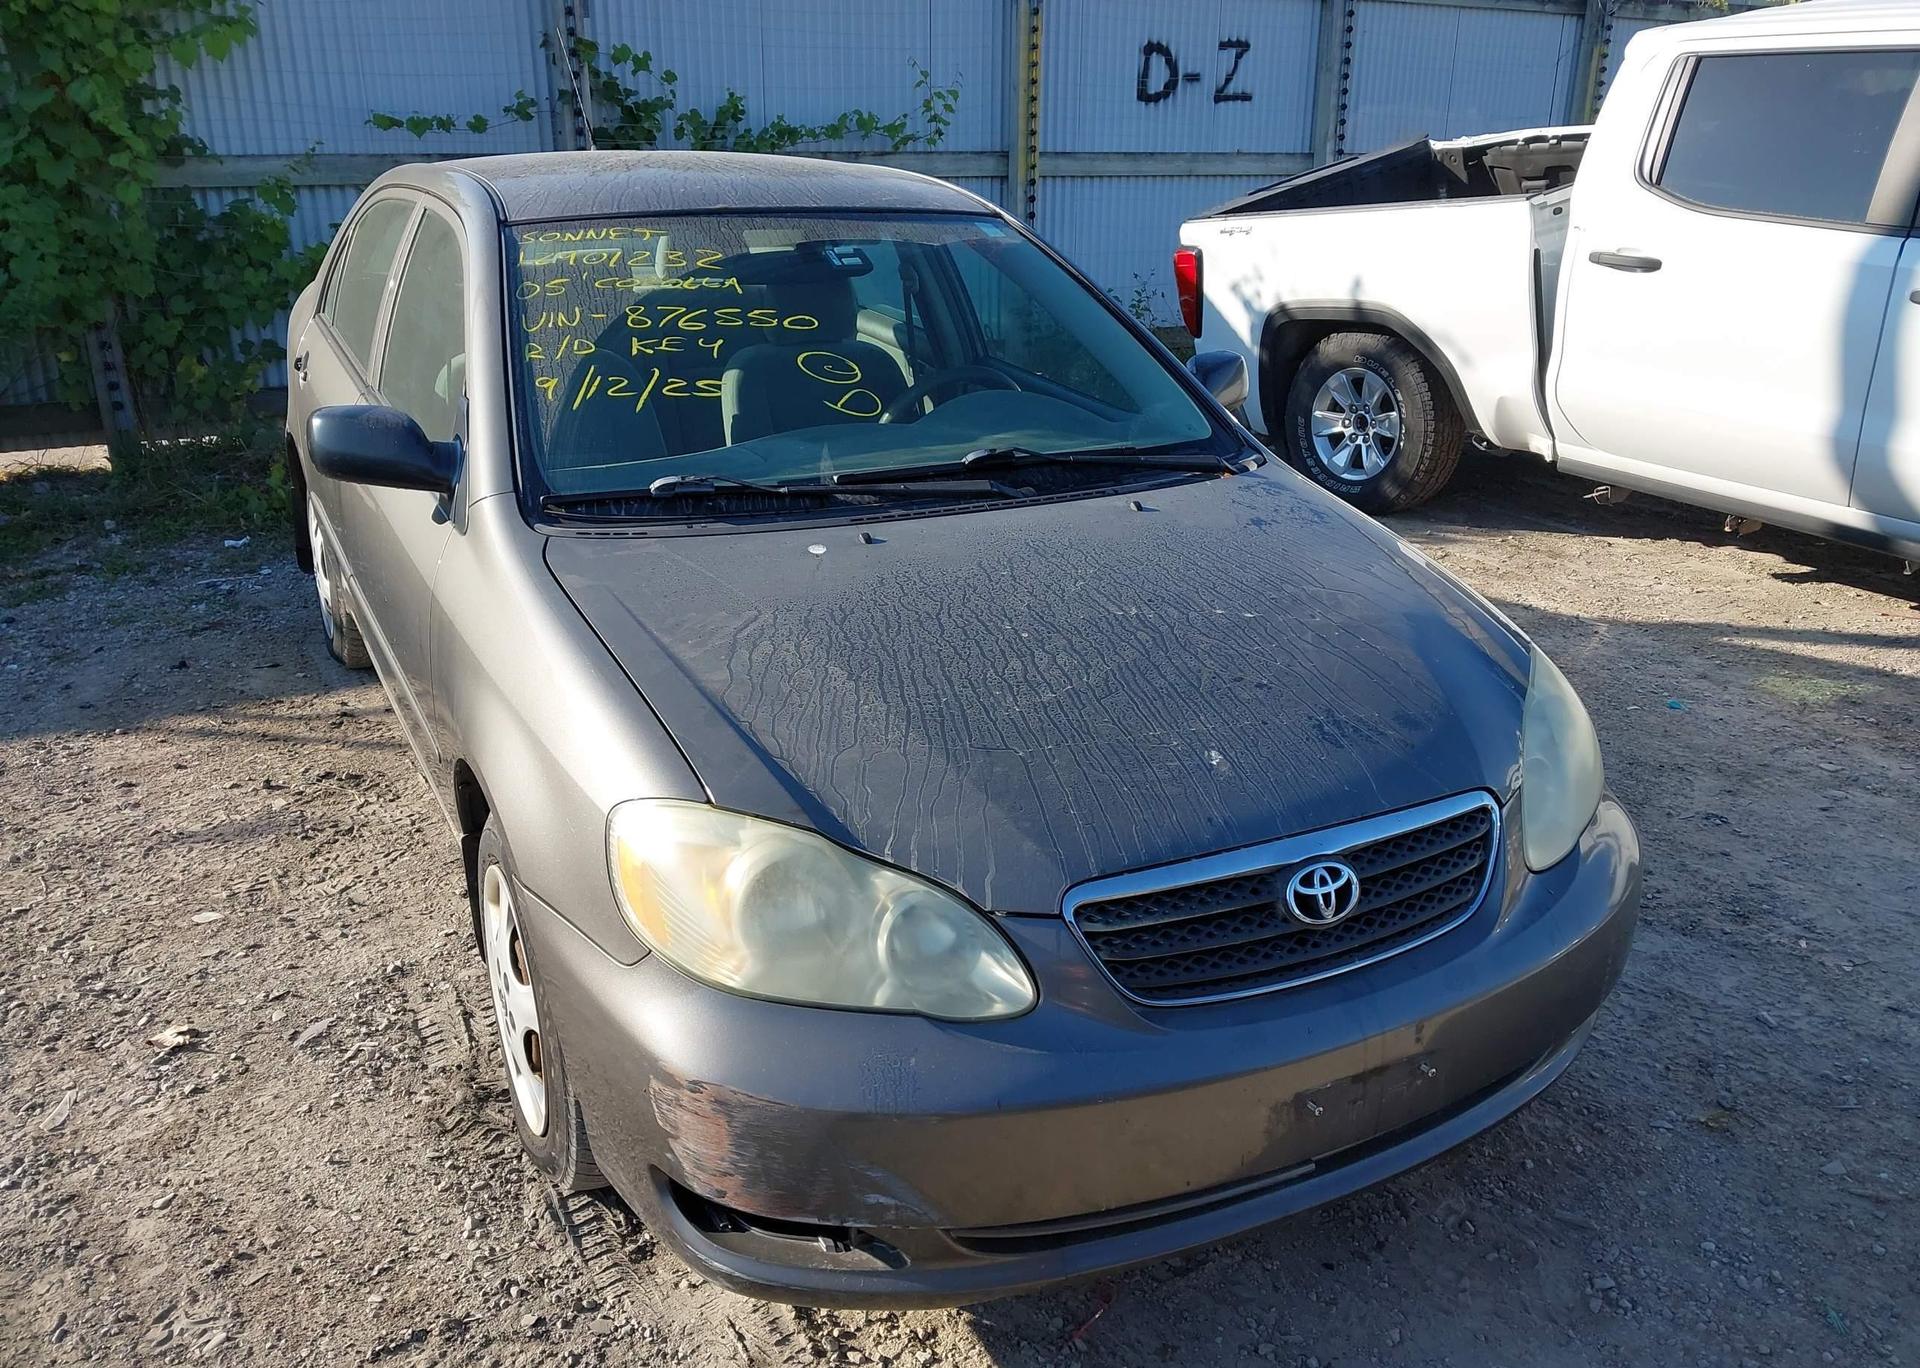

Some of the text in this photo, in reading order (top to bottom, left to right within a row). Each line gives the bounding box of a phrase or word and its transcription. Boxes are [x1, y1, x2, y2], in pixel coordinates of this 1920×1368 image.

[518, 227, 669, 244] SONNET
[595, 276, 743, 295] COOLLA
[625, 305, 820, 330] 876550
